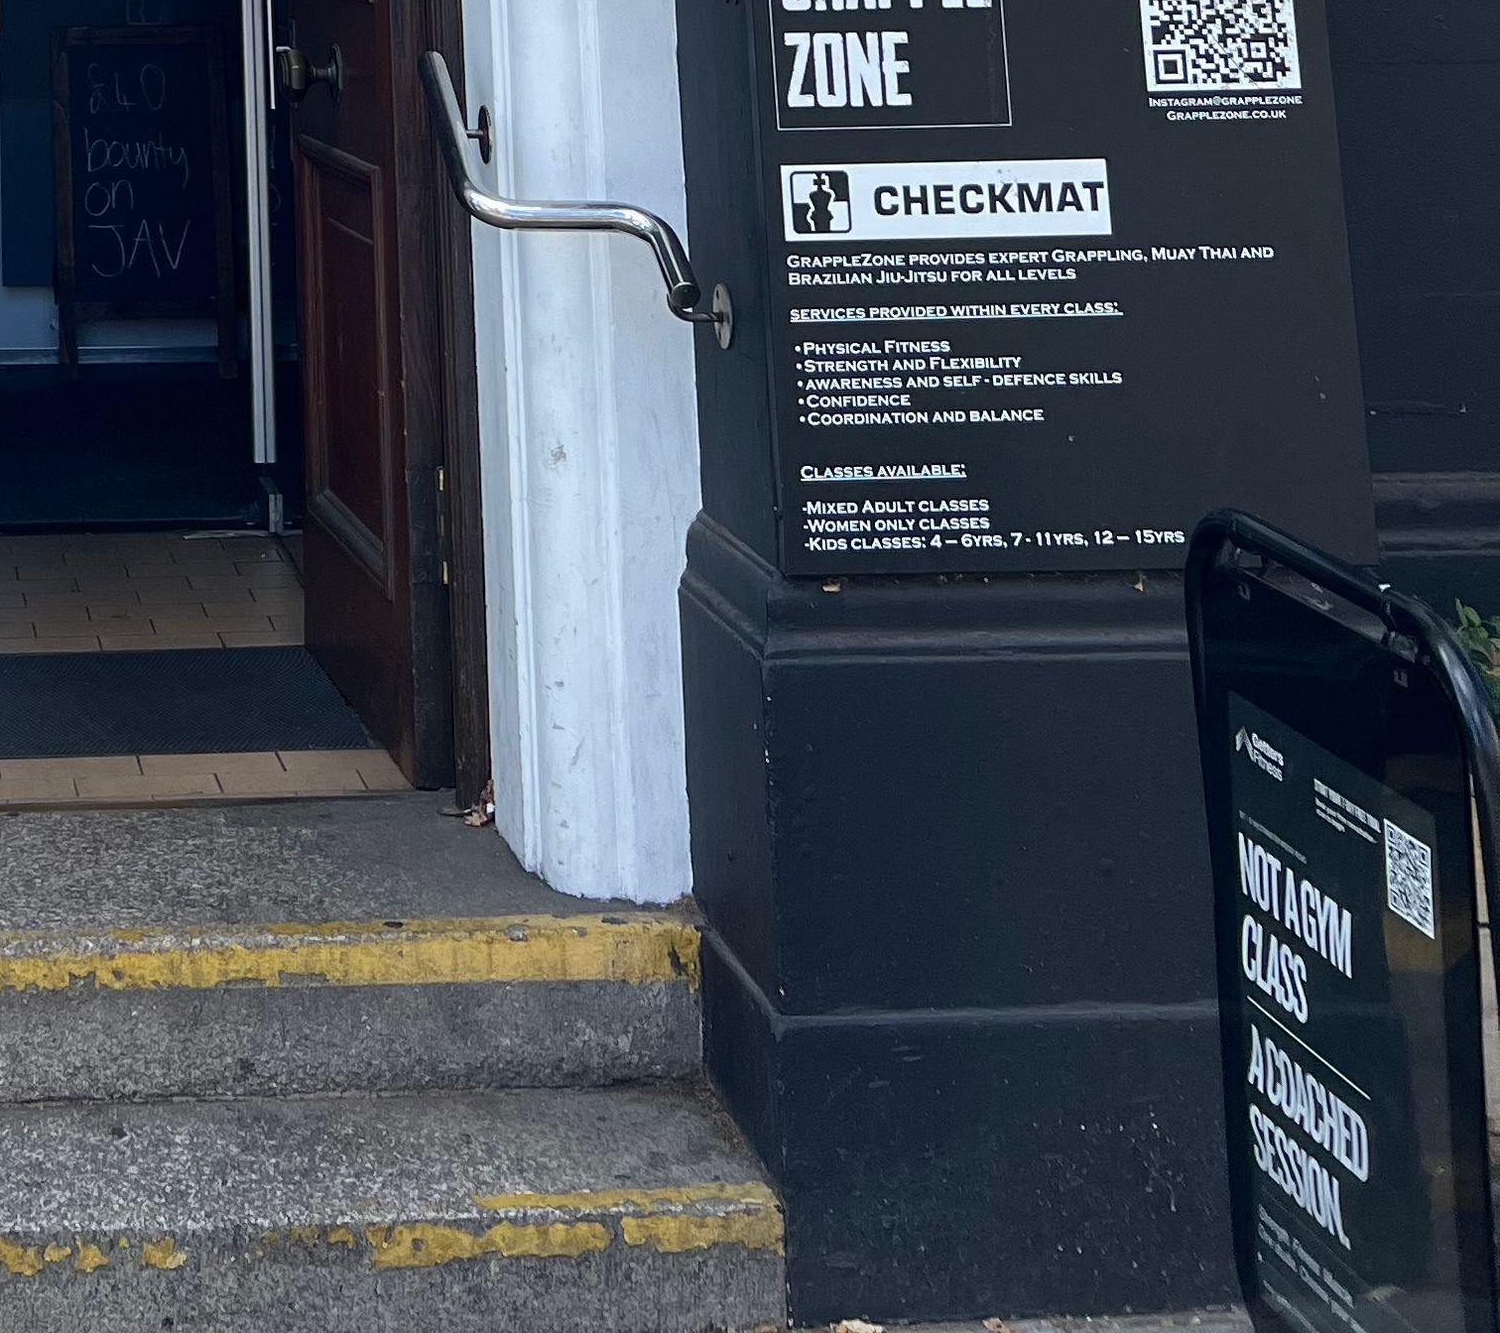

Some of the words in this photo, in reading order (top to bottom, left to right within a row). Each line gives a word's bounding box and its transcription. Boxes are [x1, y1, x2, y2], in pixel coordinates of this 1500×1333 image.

[784, 30, 913, 108] ZONE
[1166, 109, 1287, 121] GRAPPLEZONE.CO.UK
[83, 127, 189, 189] bounty
[84, 179, 134, 216] on
[872, 181, 1105, 217] CHECKMAT
[87, 218, 192, 278] JAV
[786, 253, 906, 269] GRAPPLEZONE
[908, 252, 986, 266] PROVIDES
[988, 251, 1049, 264] EXPERT
[1051, 248, 1148, 263] GRAPPLING,
[1150, 247, 1196, 261] MUAY
[1198, 245, 1237, 259] THAI
[1240, 246, 1275, 259] AND
[788, 270, 873, 286] BRAZILIAN
[876, 270, 948, 284] JIU-JITSU
[951, 270, 983, 283] FOR
[985, 269, 1016, 282] ALL
[1018, 267, 1077, 281] LEVELS
[790, 308, 866, 320] SERVICES
[869, 306, 948, 318] PROVIDED
[950, 304, 1007, 317] WITHIN
[1010, 303, 1061, 316] EVERY
[1063, 301, 1119, 315] CLASS:
[803, 342, 882, 355] PHYSICAL
[884, 339, 951, 354] FITNESS
[804, 359, 889, 373] STRENGTH
[892, 358, 927, 371] AND
[930, 356, 1022, 370] FLEXIBILITY
[806, 377, 903, 390] AWARENESS
[905, 376, 941, 389] AND
[943, 375, 982, 388] SELF
[993, 374, 1067, 387] DEFENCE
[1069, 371, 1123, 385] SKILLS
[806, 394, 912, 408] CONFIDENCE
[808, 412, 929, 426] COORDINATION
[932, 411, 967, 424] AND
[970, 408, 1045, 423] BALANCE
[800, 466, 874, 481] CLASSES
[876, 464, 966, 479] AVAILABLE:
[861, 500, 916, 514] ADULT
[918, 499, 990, 513] CLASSES
[874, 518, 916, 532] ONLY
[918, 517, 991, 531] CLASSES
[850, 536, 927, 551] CLASSES:
[929, 533, 943, 549] 4
[961, 533, 1008, 549] 6YRS,
[1010, 532, 1023, 547] 7
[1035, 531, 1089, 548] 11YRS,
[1093, 530, 1115, 545] 12
[1134, 529, 1186, 544] 15YRS
[1238, 831, 1283, 921] NOT
[1284, 866, 1301, 939] A
[1300, 878, 1353, 979] GYM
[1241, 914, 1308, 1025] CLASS
[1248, 1023, 1264, 1094] A
[1265, 1037, 1369, 1183] COACHED
[1249, 1102, 1351, 1251] SESSION.
